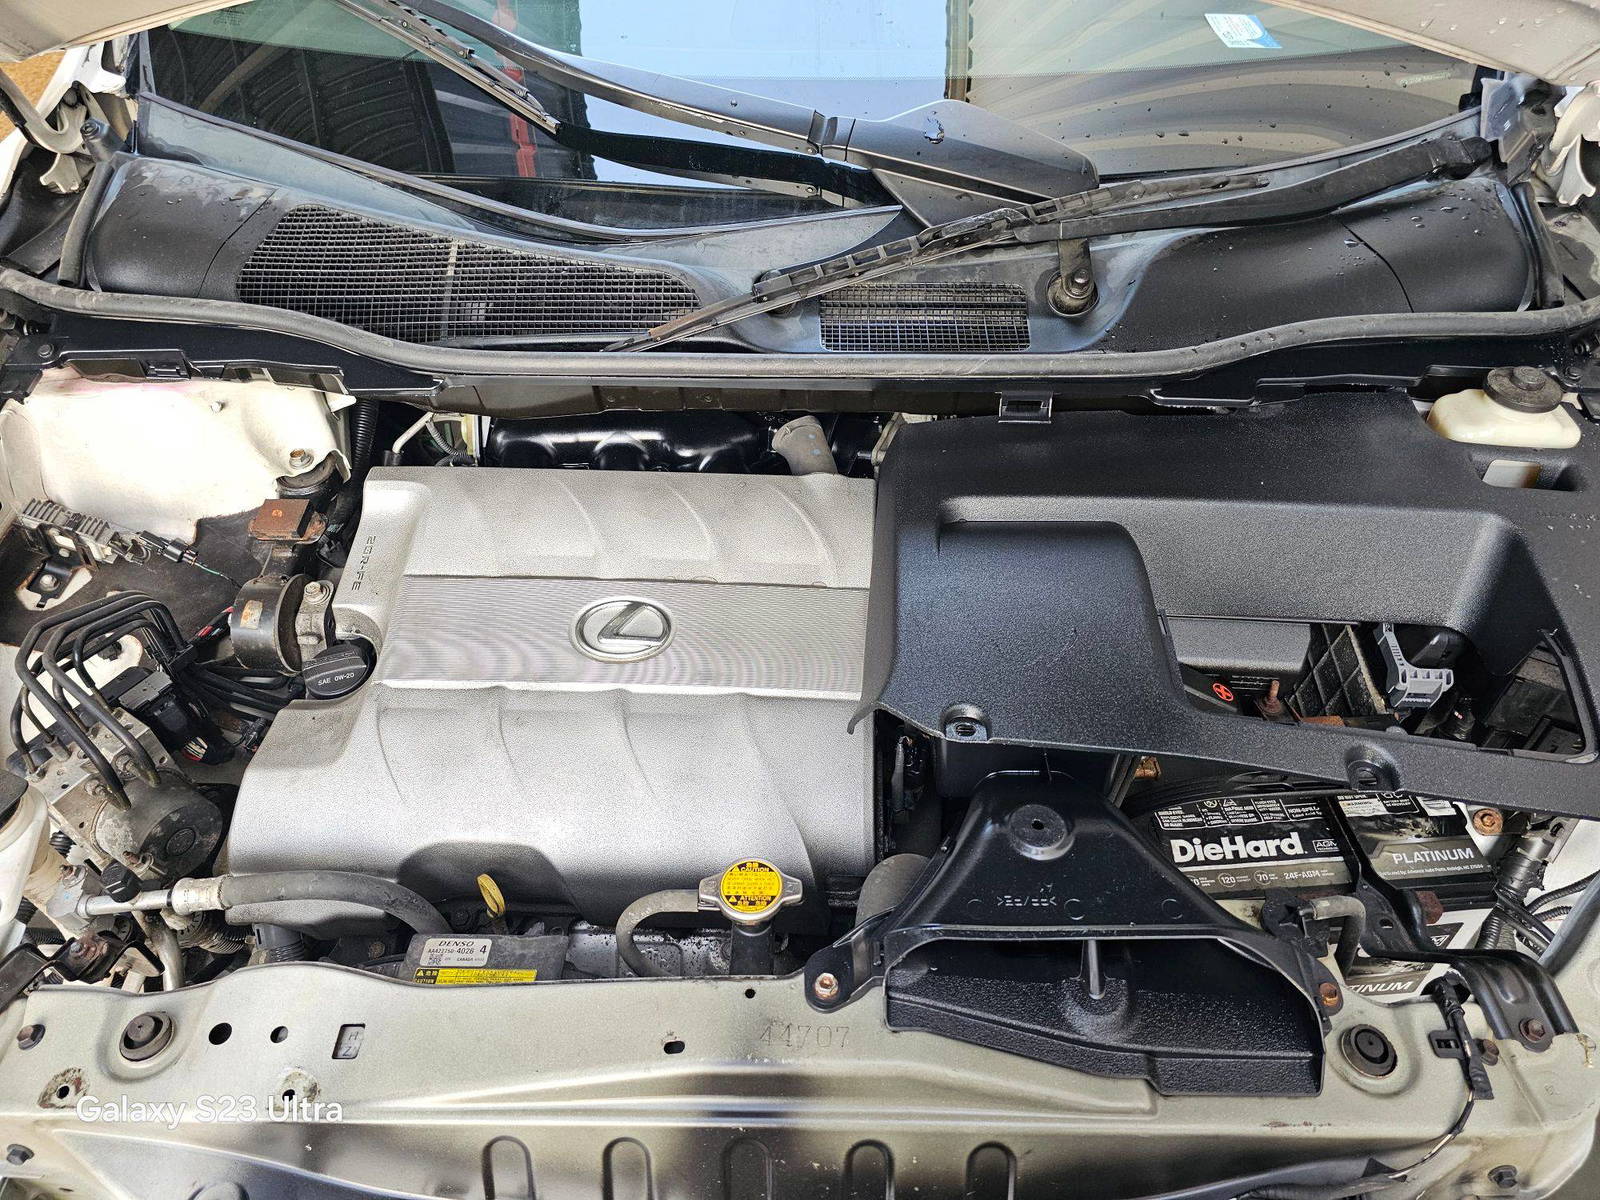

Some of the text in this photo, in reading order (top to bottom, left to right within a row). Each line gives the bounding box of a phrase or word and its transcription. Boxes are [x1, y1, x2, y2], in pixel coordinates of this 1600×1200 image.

[317, 672, 355, 686] SAE 0W-20
[1170, 831, 1305, 864] DieHard
[1391, 847, 1475, 865] PLATINUM
[1220, 874, 1236, 884] 120
[1256, 872, 1269, 882] 70
[479, 944, 488, 955] 4
